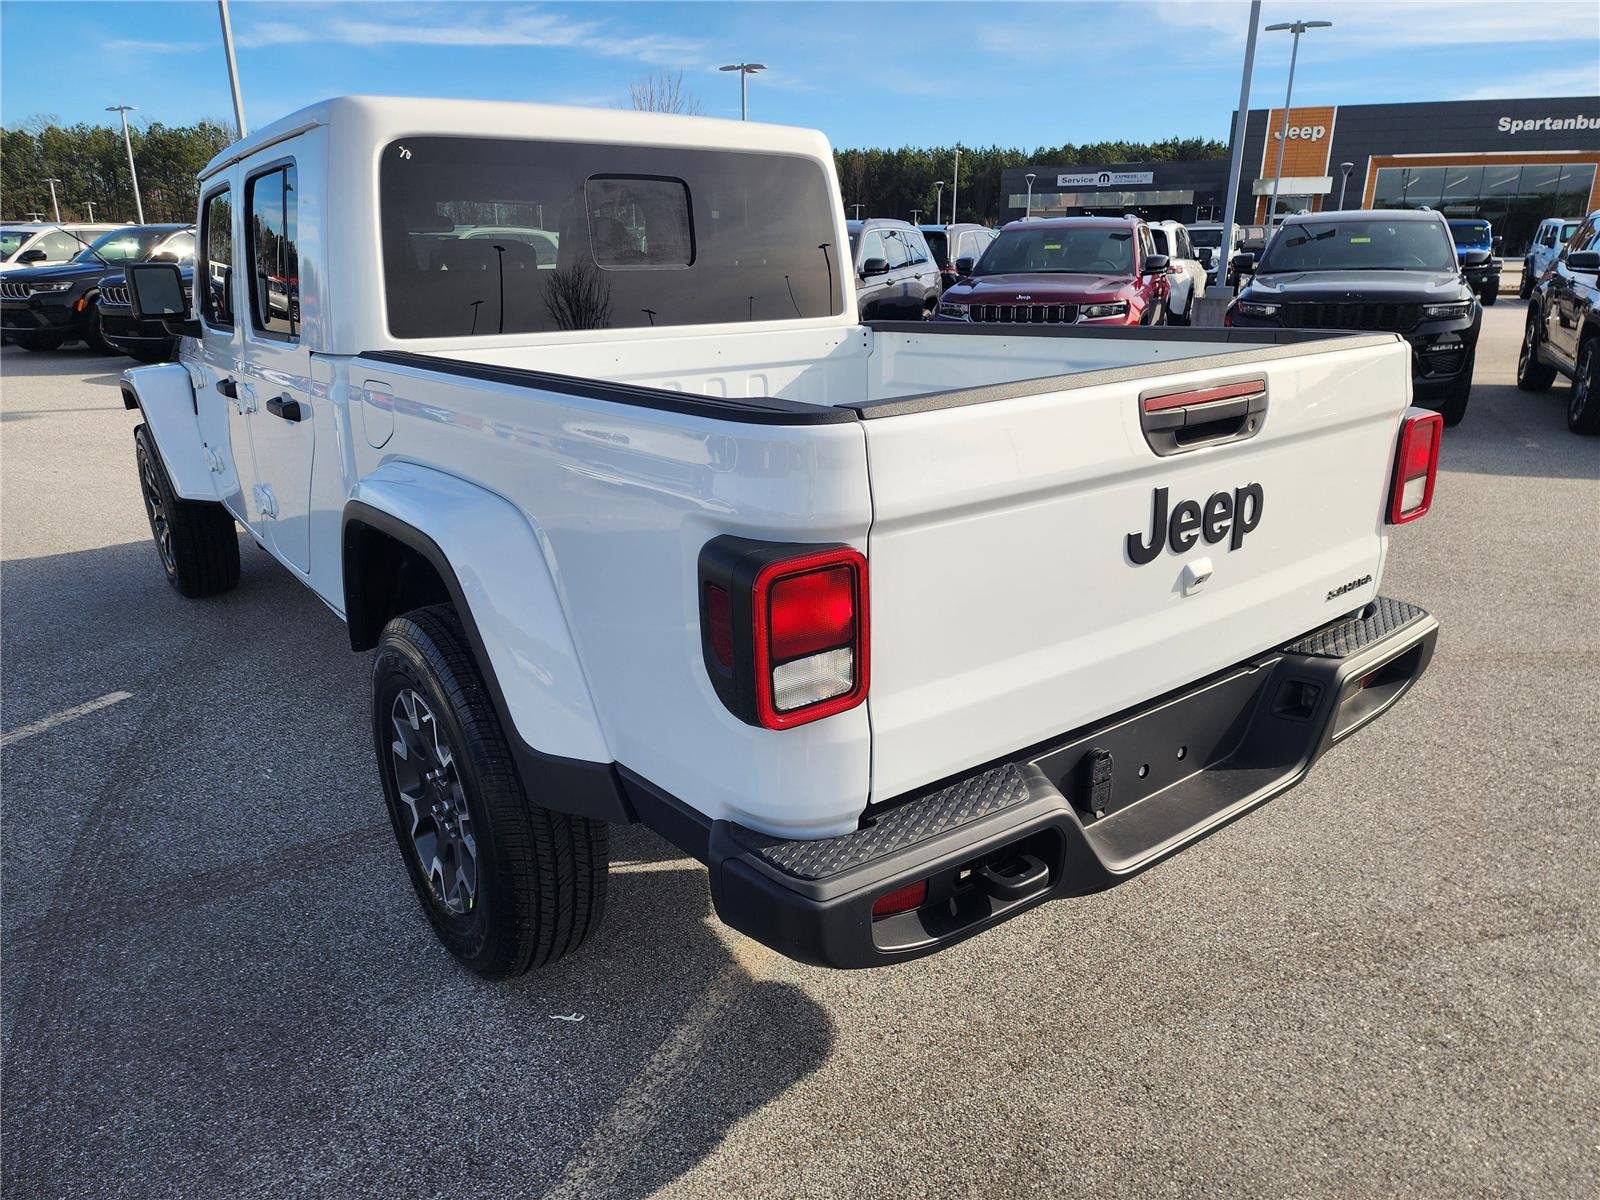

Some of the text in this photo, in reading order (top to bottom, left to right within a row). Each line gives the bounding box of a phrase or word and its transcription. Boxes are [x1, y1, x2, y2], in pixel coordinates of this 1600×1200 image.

[1274, 122, 1325, 141] Jeep
[1498, 115, 1600, 134] Spartanbu
[1062, 176, 1094, 184] Service
[1127, 481, 1264, 565] Jeep
